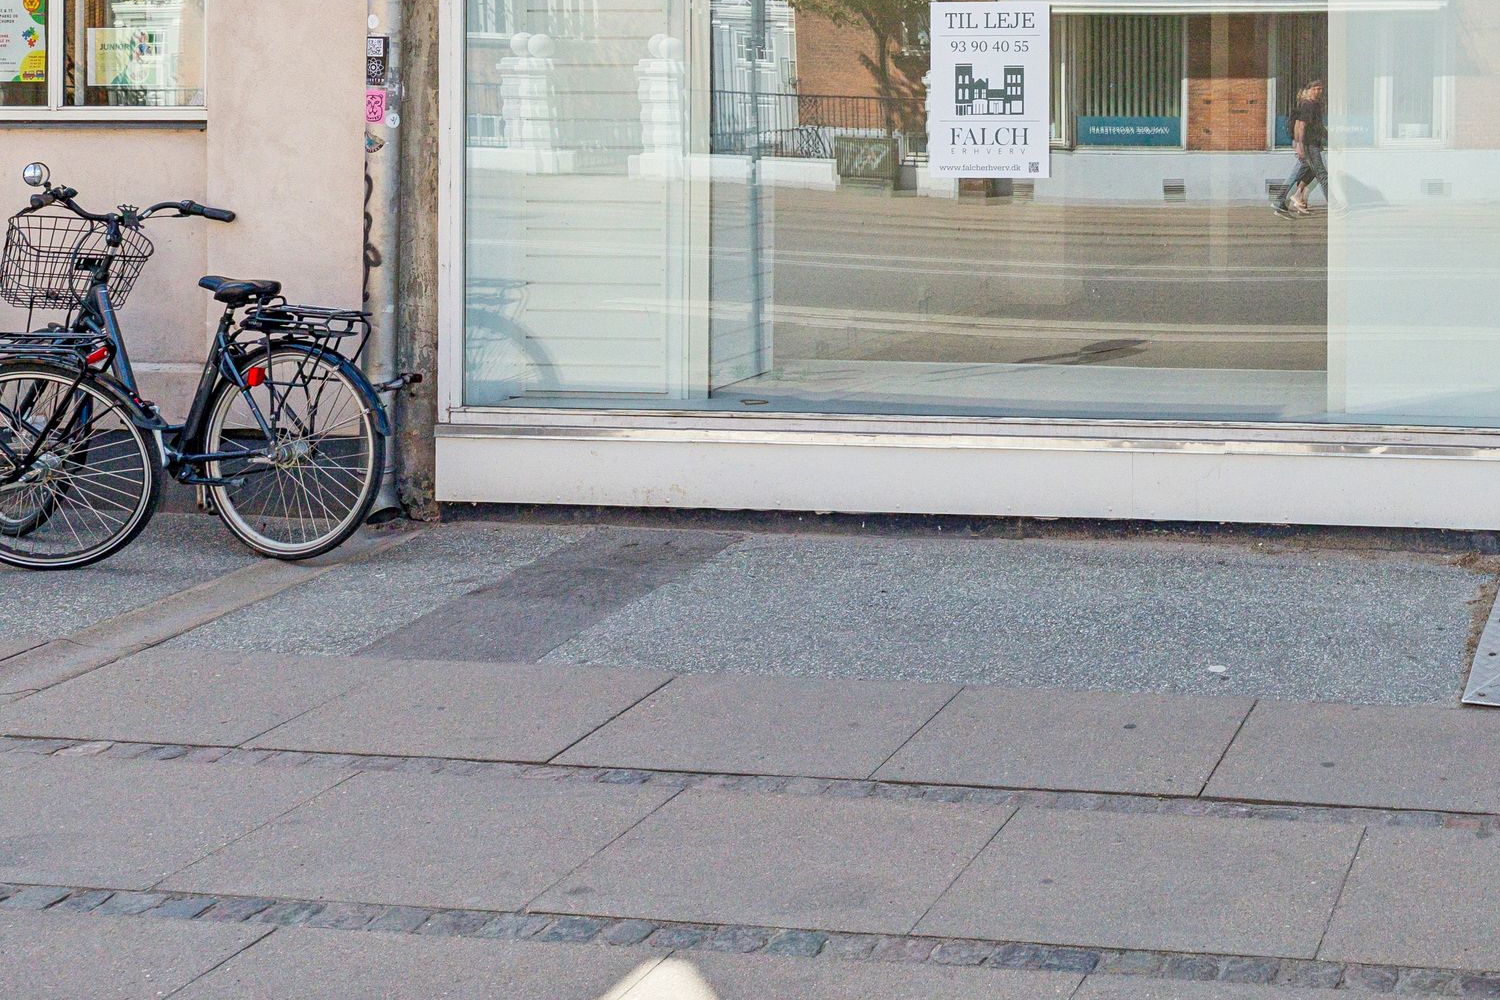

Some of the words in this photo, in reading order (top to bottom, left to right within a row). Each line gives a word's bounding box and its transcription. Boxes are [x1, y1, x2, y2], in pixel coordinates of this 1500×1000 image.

[945, 12, 978, 29] TIL
[984, 12, 1035, 29] LEJE
[950, 40, 966, 53] 93
[970, 40, 988, 53] 90
[992, 40, 1010, 53] 40
[1013, 40, 1029, 53] 55
[950, 127, 1029, 146] FALCH
[939, 164, 1021, 172] www.falcherhverv.dk
